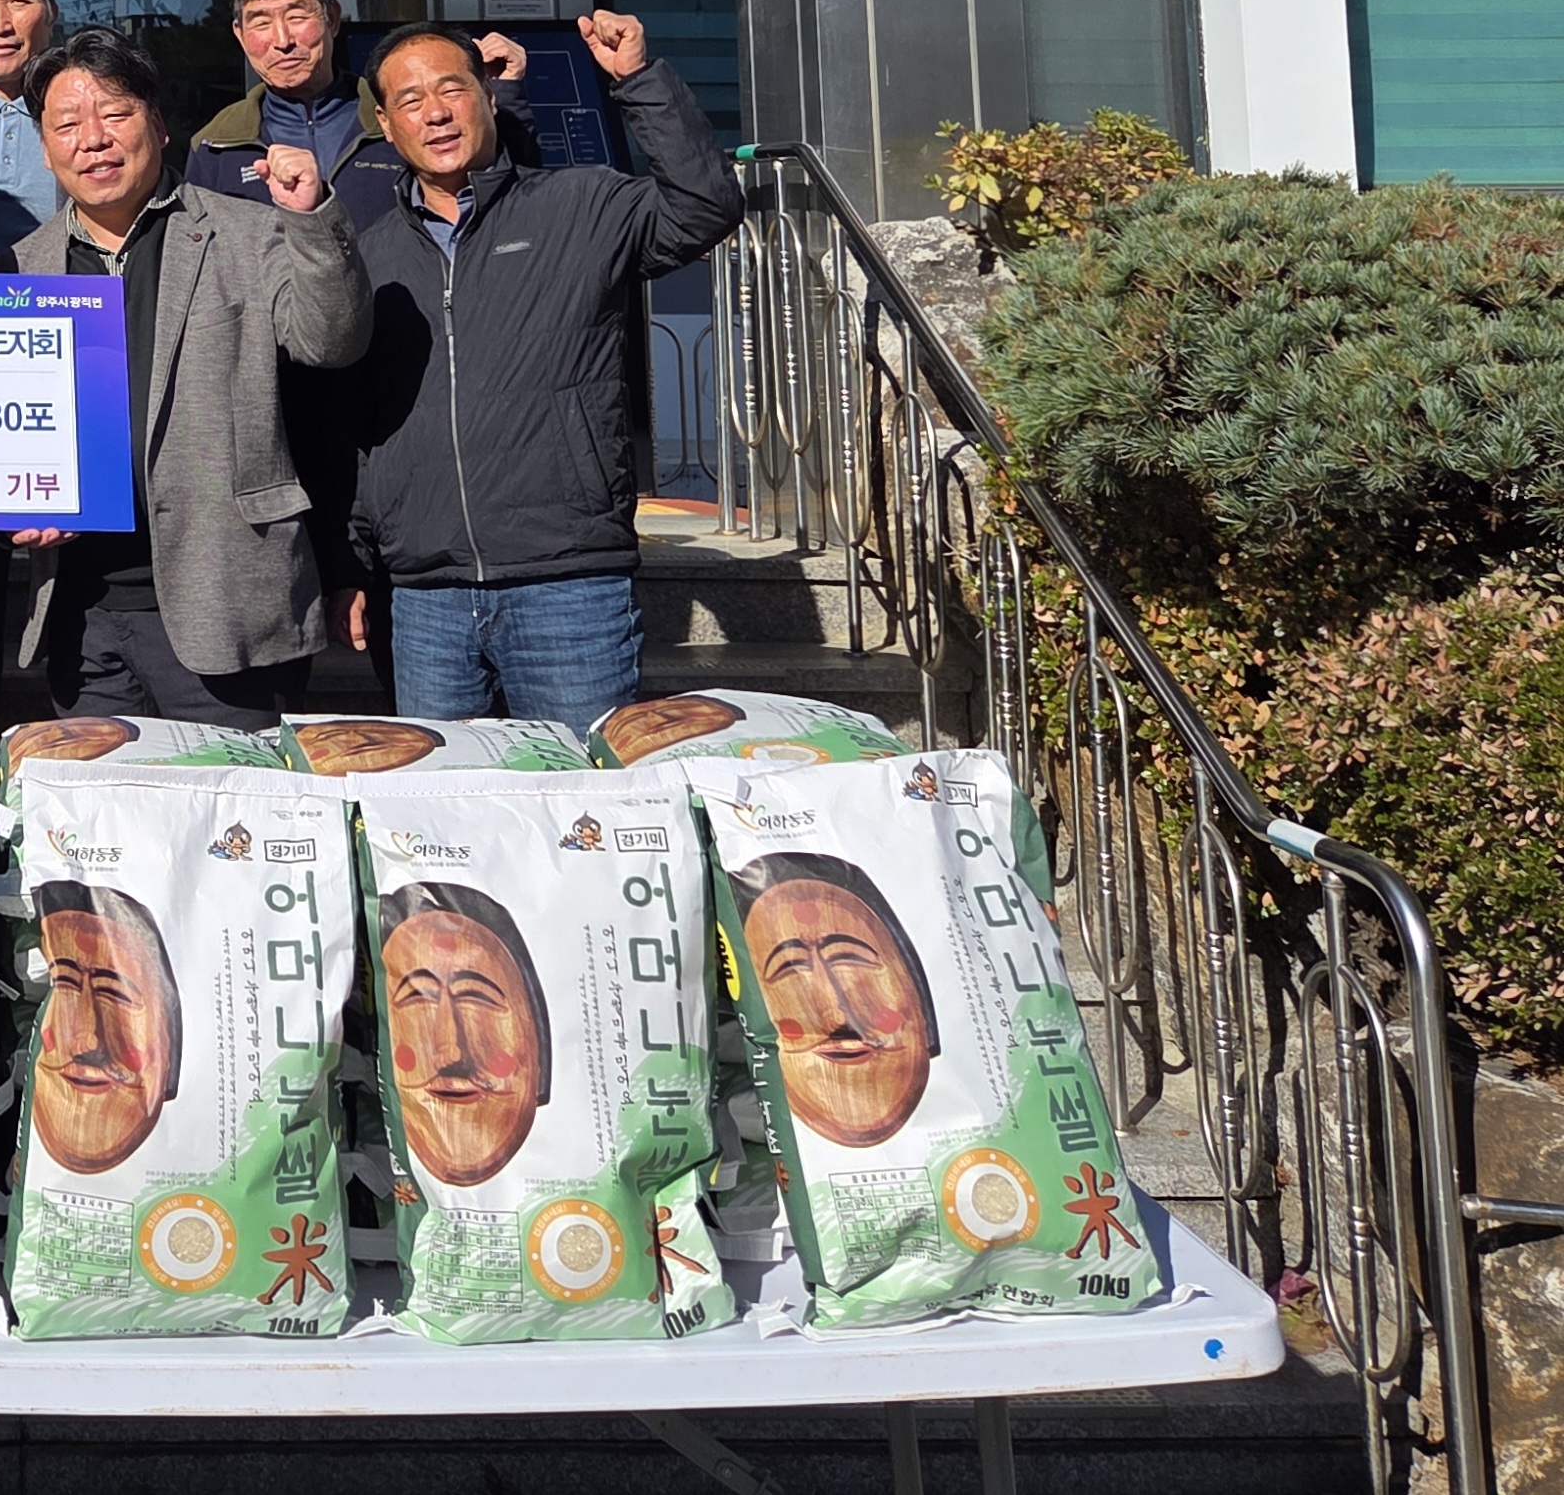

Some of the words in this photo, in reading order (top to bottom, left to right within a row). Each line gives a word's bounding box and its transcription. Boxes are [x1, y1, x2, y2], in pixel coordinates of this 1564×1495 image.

[36, 296, 68, 308] 양주시
[69, 297, 104, 308] 광적면
[7, 471, 61, 500] 기부
[621, 832, 664, 848] 경기미
[270, 844, 311, 858] 경기미
[1077, 1274, 1130, 1299] 10kg
